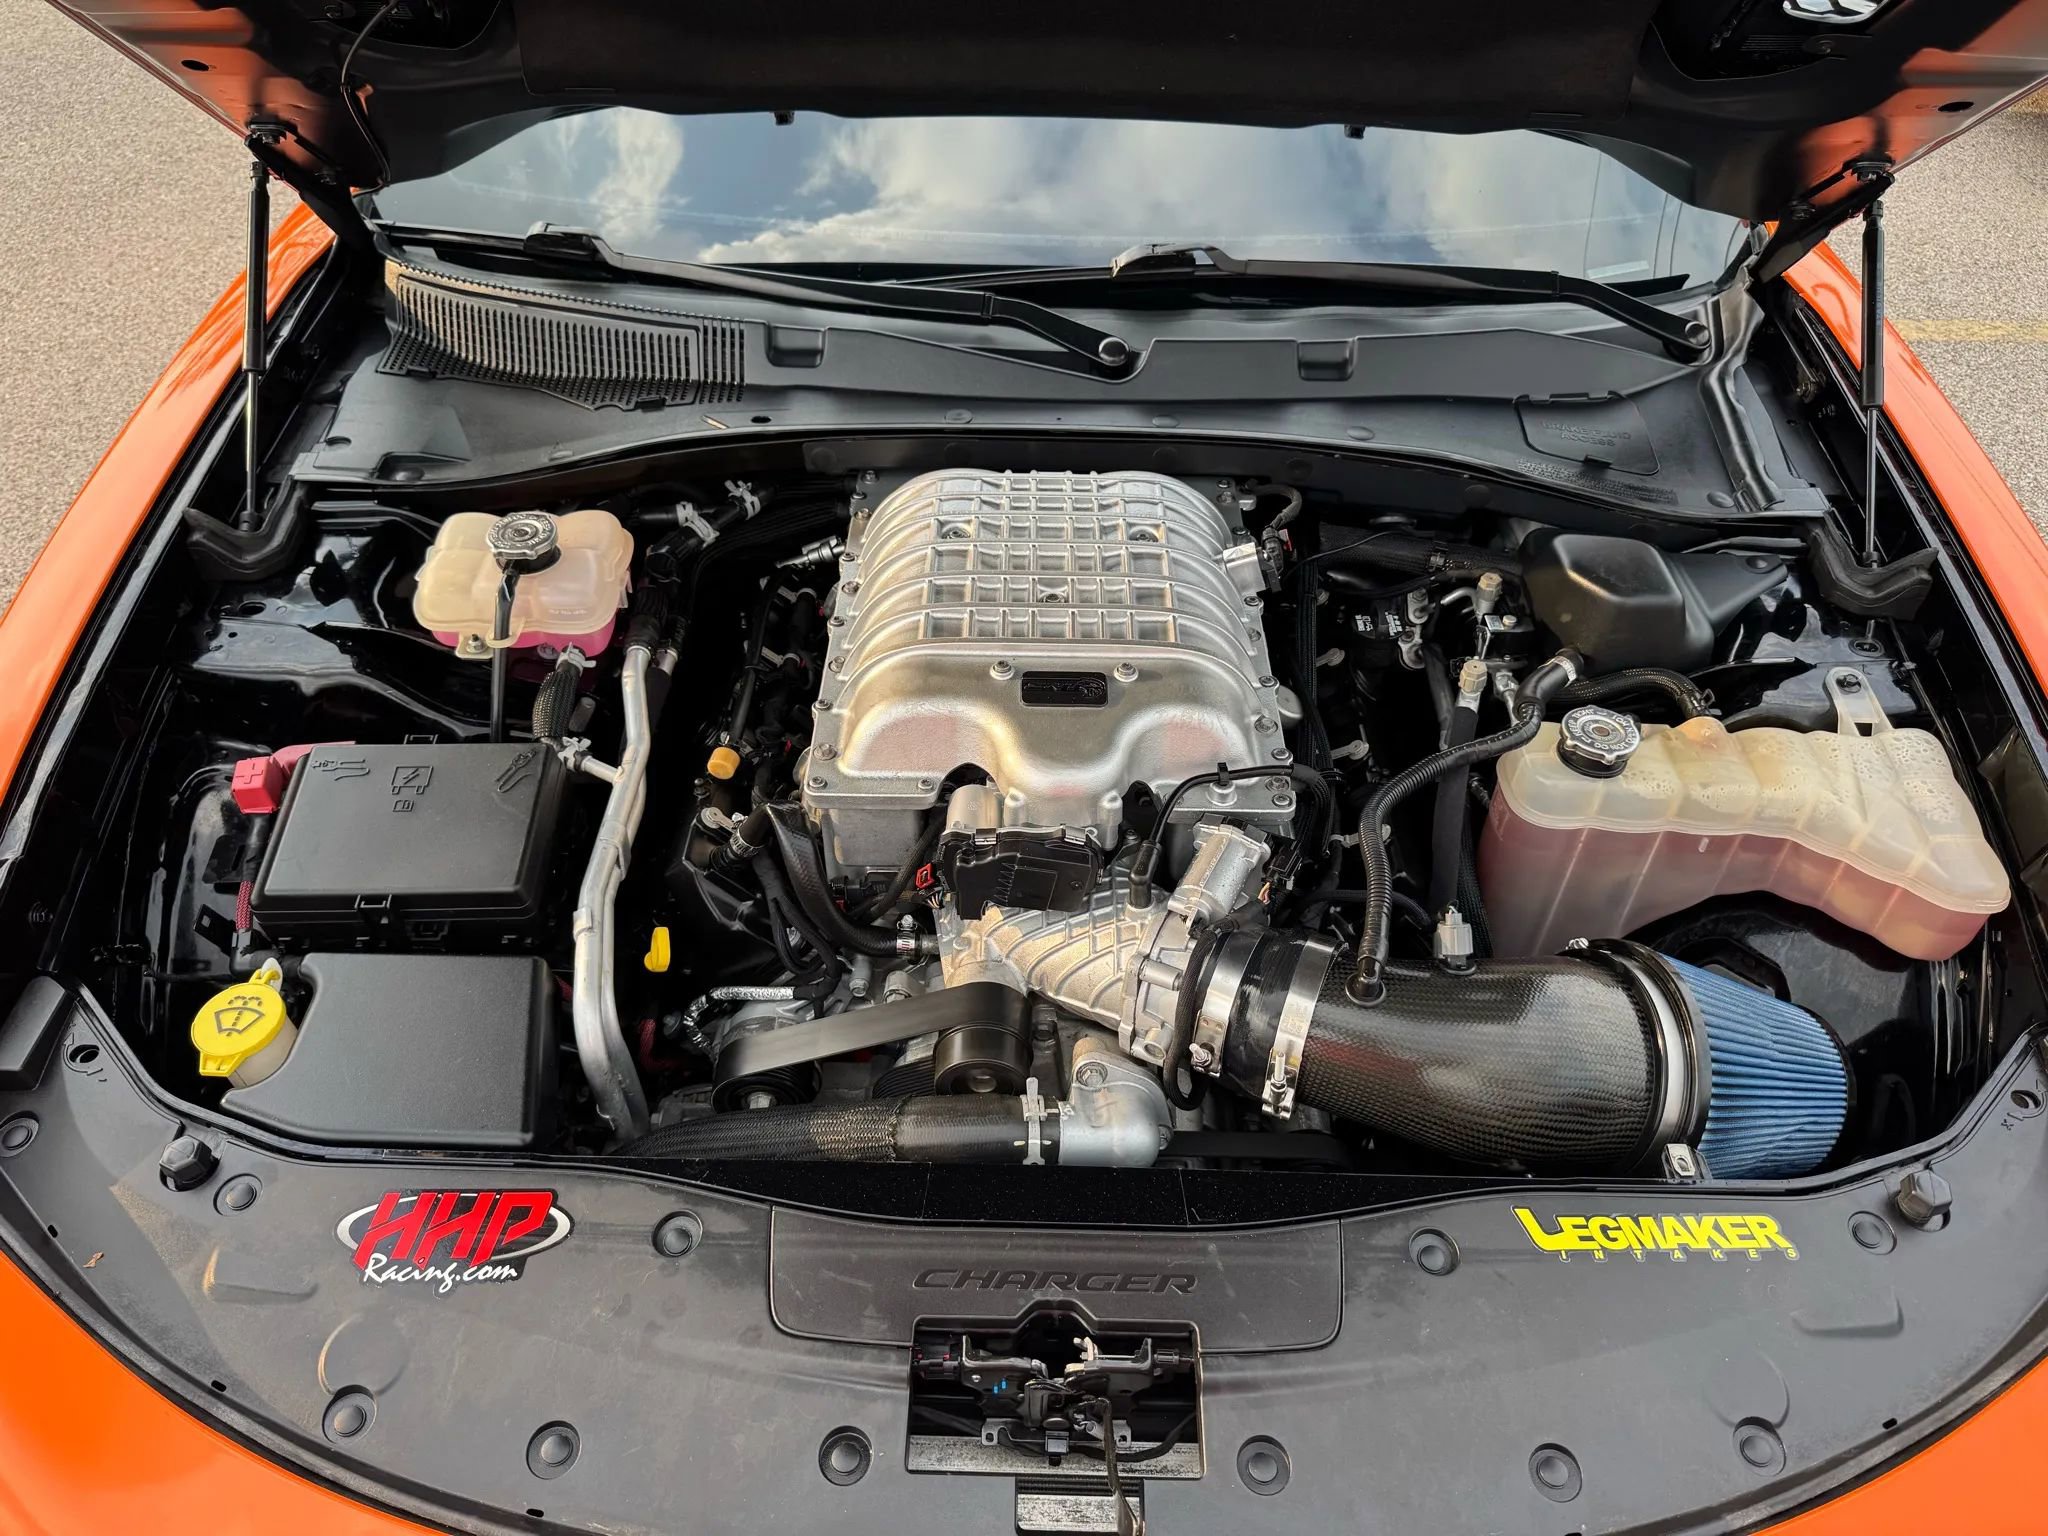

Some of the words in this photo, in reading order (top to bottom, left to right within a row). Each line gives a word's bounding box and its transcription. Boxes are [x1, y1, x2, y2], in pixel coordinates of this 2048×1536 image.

[1560, 432, 1617, 447] ACCESS
[1567, 719, 1583, 737] KEEP
[353, 1191, 553, 1271] HHP
[1514, 1207, 1793, 1250] LEGMAKER
[1560, 1249, 1798, 1259] INTAKES
[363, 1252, 518, 1293] Racing.com
[912, 1268, 1198, 1295] CHARGER
